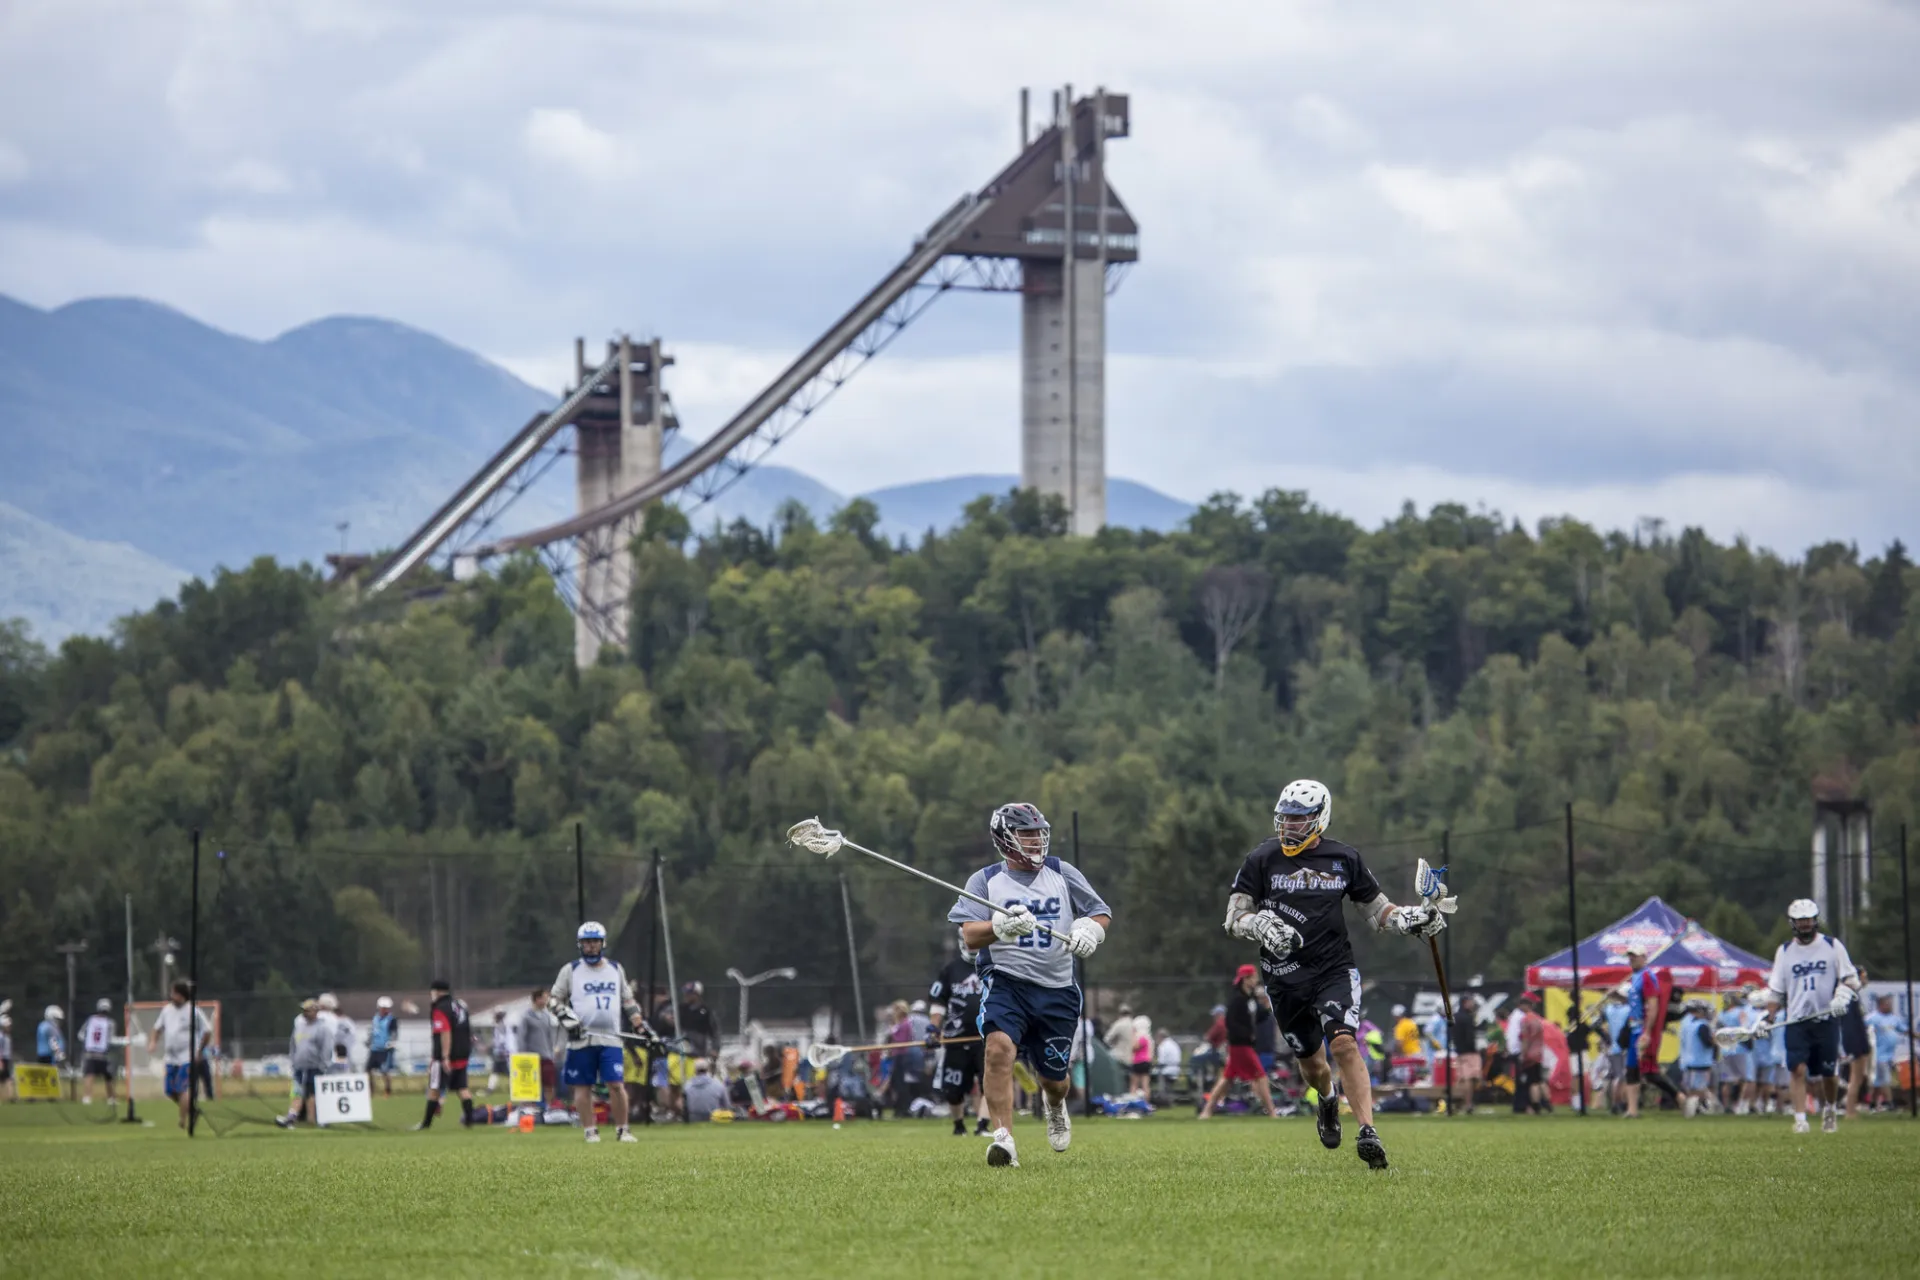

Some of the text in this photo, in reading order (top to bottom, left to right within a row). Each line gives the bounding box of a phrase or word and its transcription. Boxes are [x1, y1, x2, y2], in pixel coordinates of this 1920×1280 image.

[1270, 874, 1347, 894] High Peaks
[1279, 902, 1308, 924] WHISKEY
[1272, 961, 1300, 976] CROSSE
[1803, 976, 1815, 992] 11
[595, 996, 611, 1010] 17
[944, 1067, 963, 1086] 20
[321, 1080, 365, 1094] FIELD
[338, 1096, 351, 1114] 6
